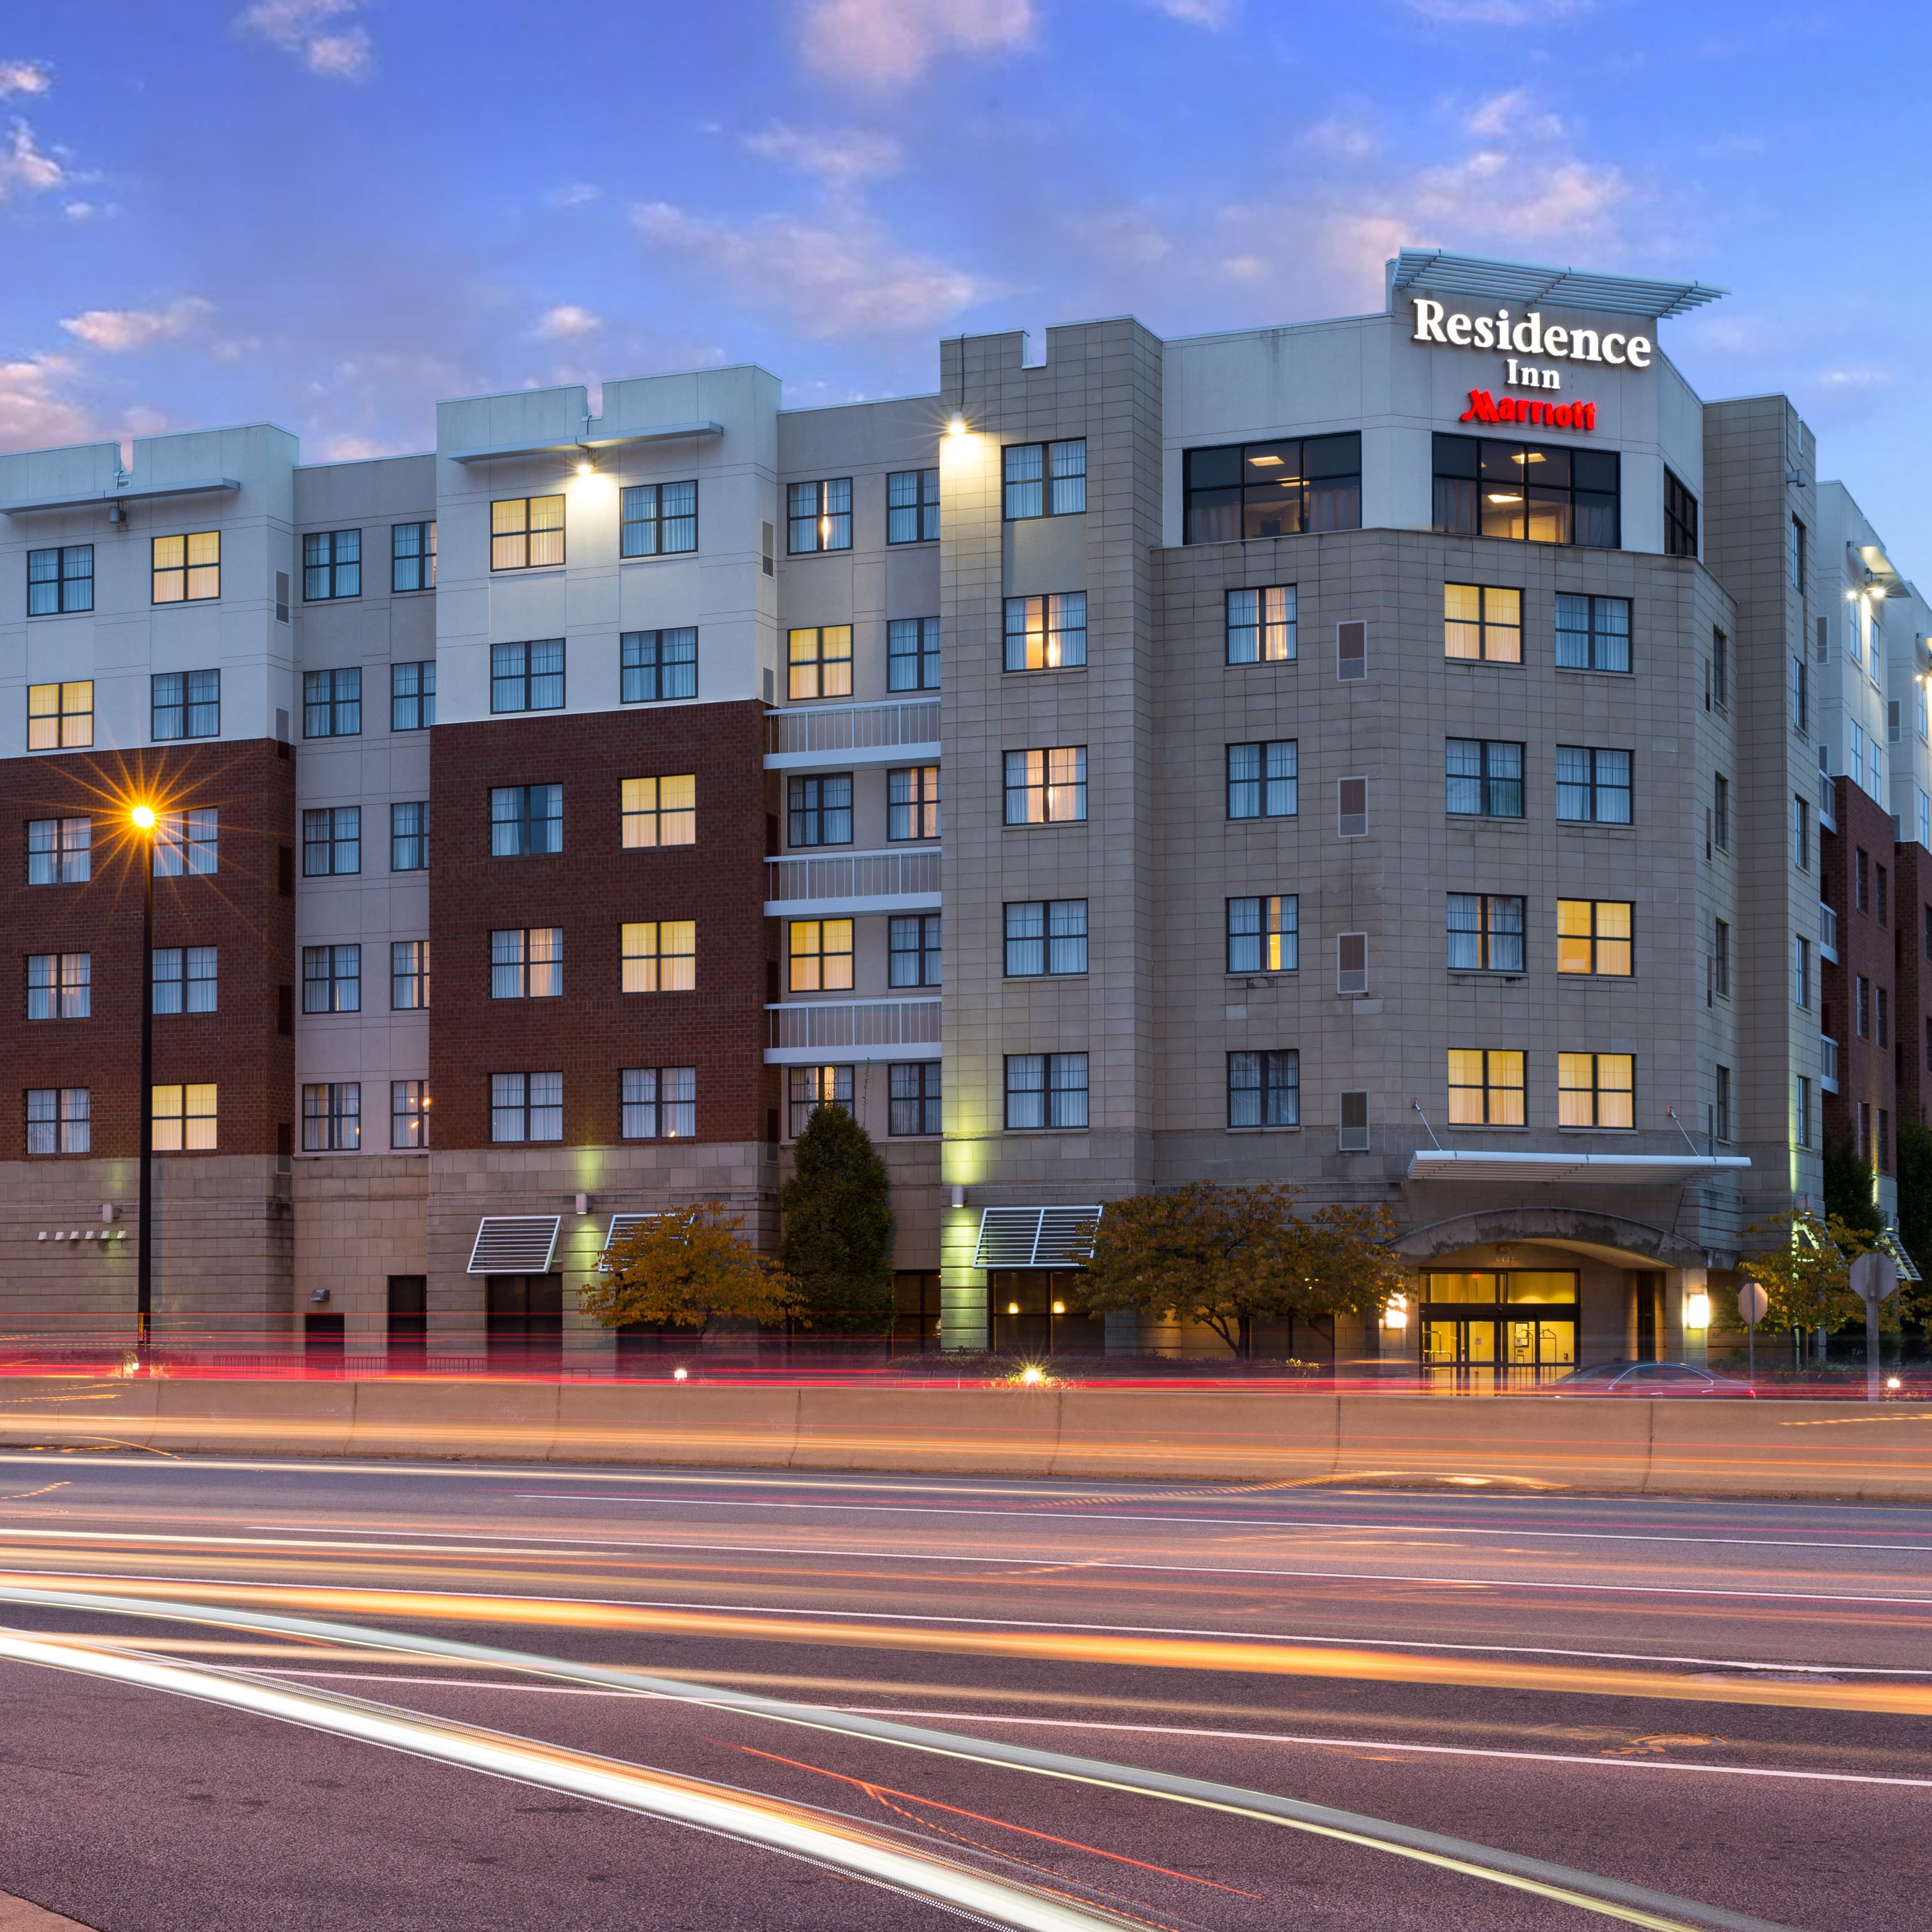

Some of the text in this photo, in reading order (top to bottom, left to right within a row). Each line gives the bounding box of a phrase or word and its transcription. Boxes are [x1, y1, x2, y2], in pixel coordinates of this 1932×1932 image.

[1412, 298, 1651, 368] Residence
[1506, 359, 1561, 389] Inn
[1461, 388, 1596, 430] Marriott
